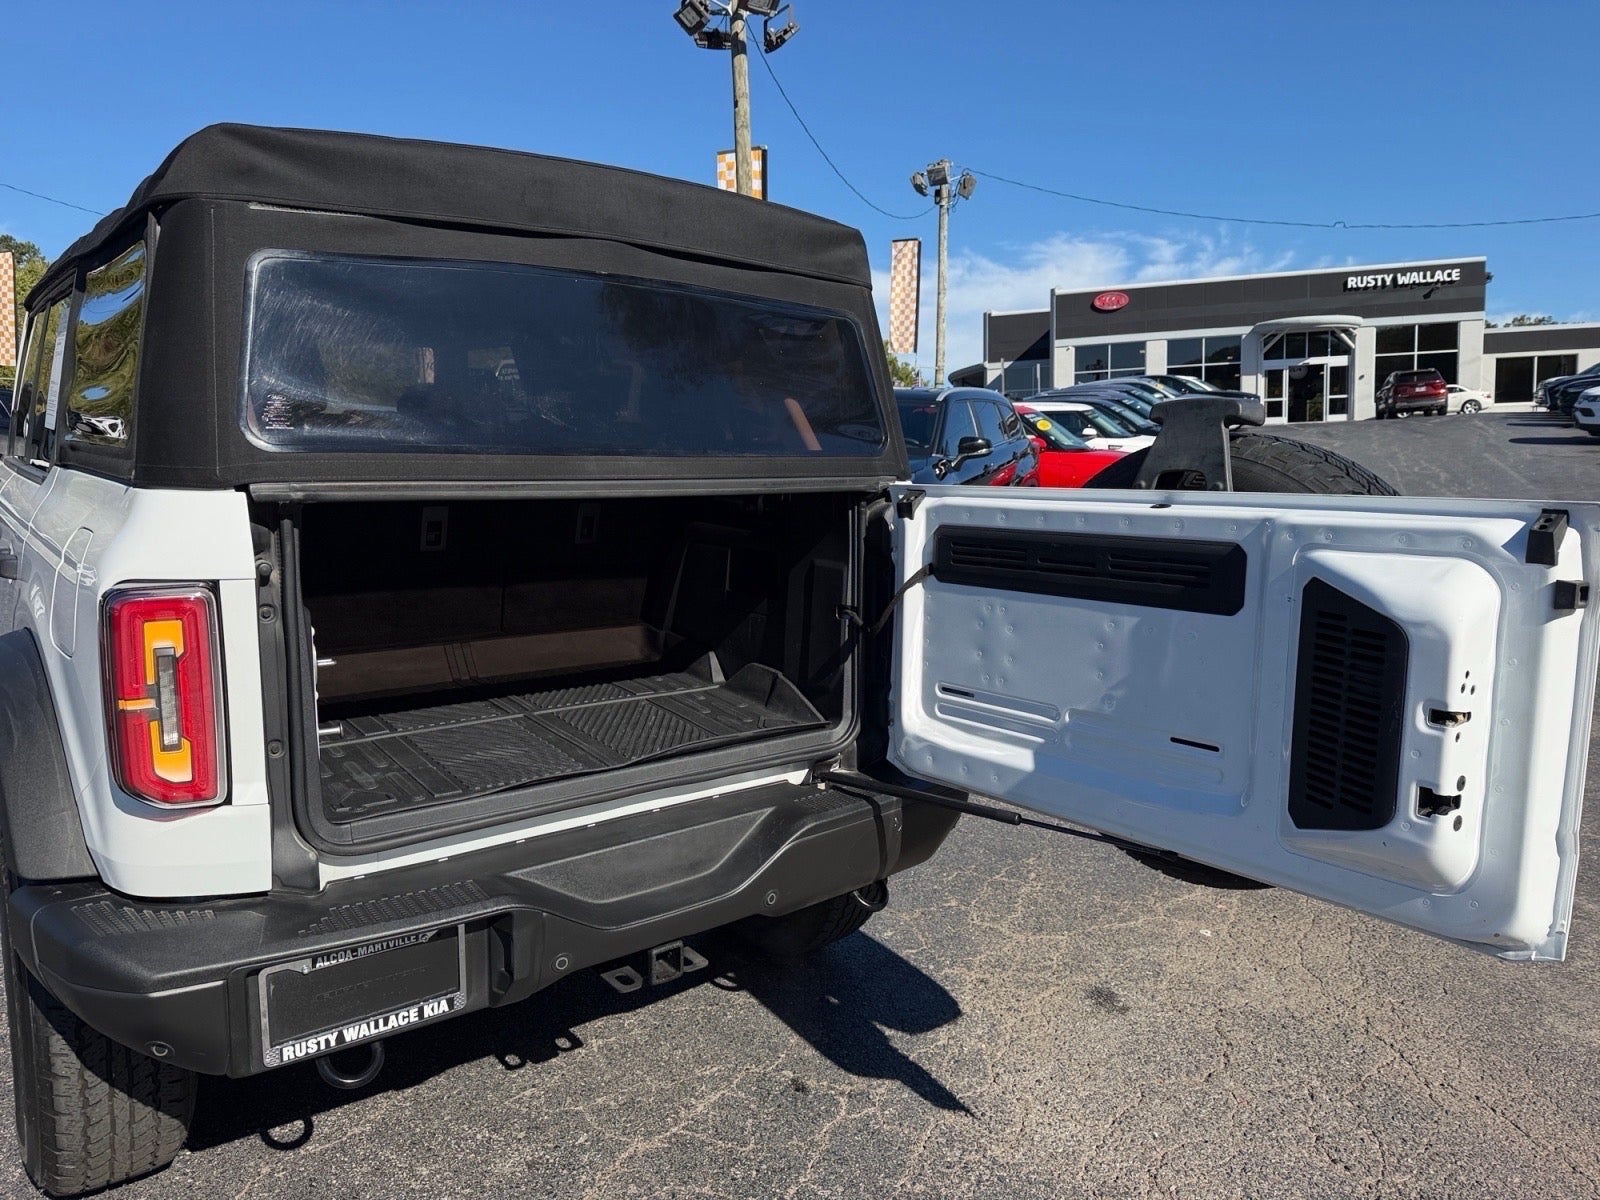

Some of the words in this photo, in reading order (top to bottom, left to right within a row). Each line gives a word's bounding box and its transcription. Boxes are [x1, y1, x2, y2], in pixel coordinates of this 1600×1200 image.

[1347, 273, 1393, 289] RUSTY
[1397, 268, 1460, 285] WALLACE
[282, 1031, 339, 1061] RUSTY
[342, 1008, 419, 1043] WALLACE
[423, 999, 450, 1018] KIA
